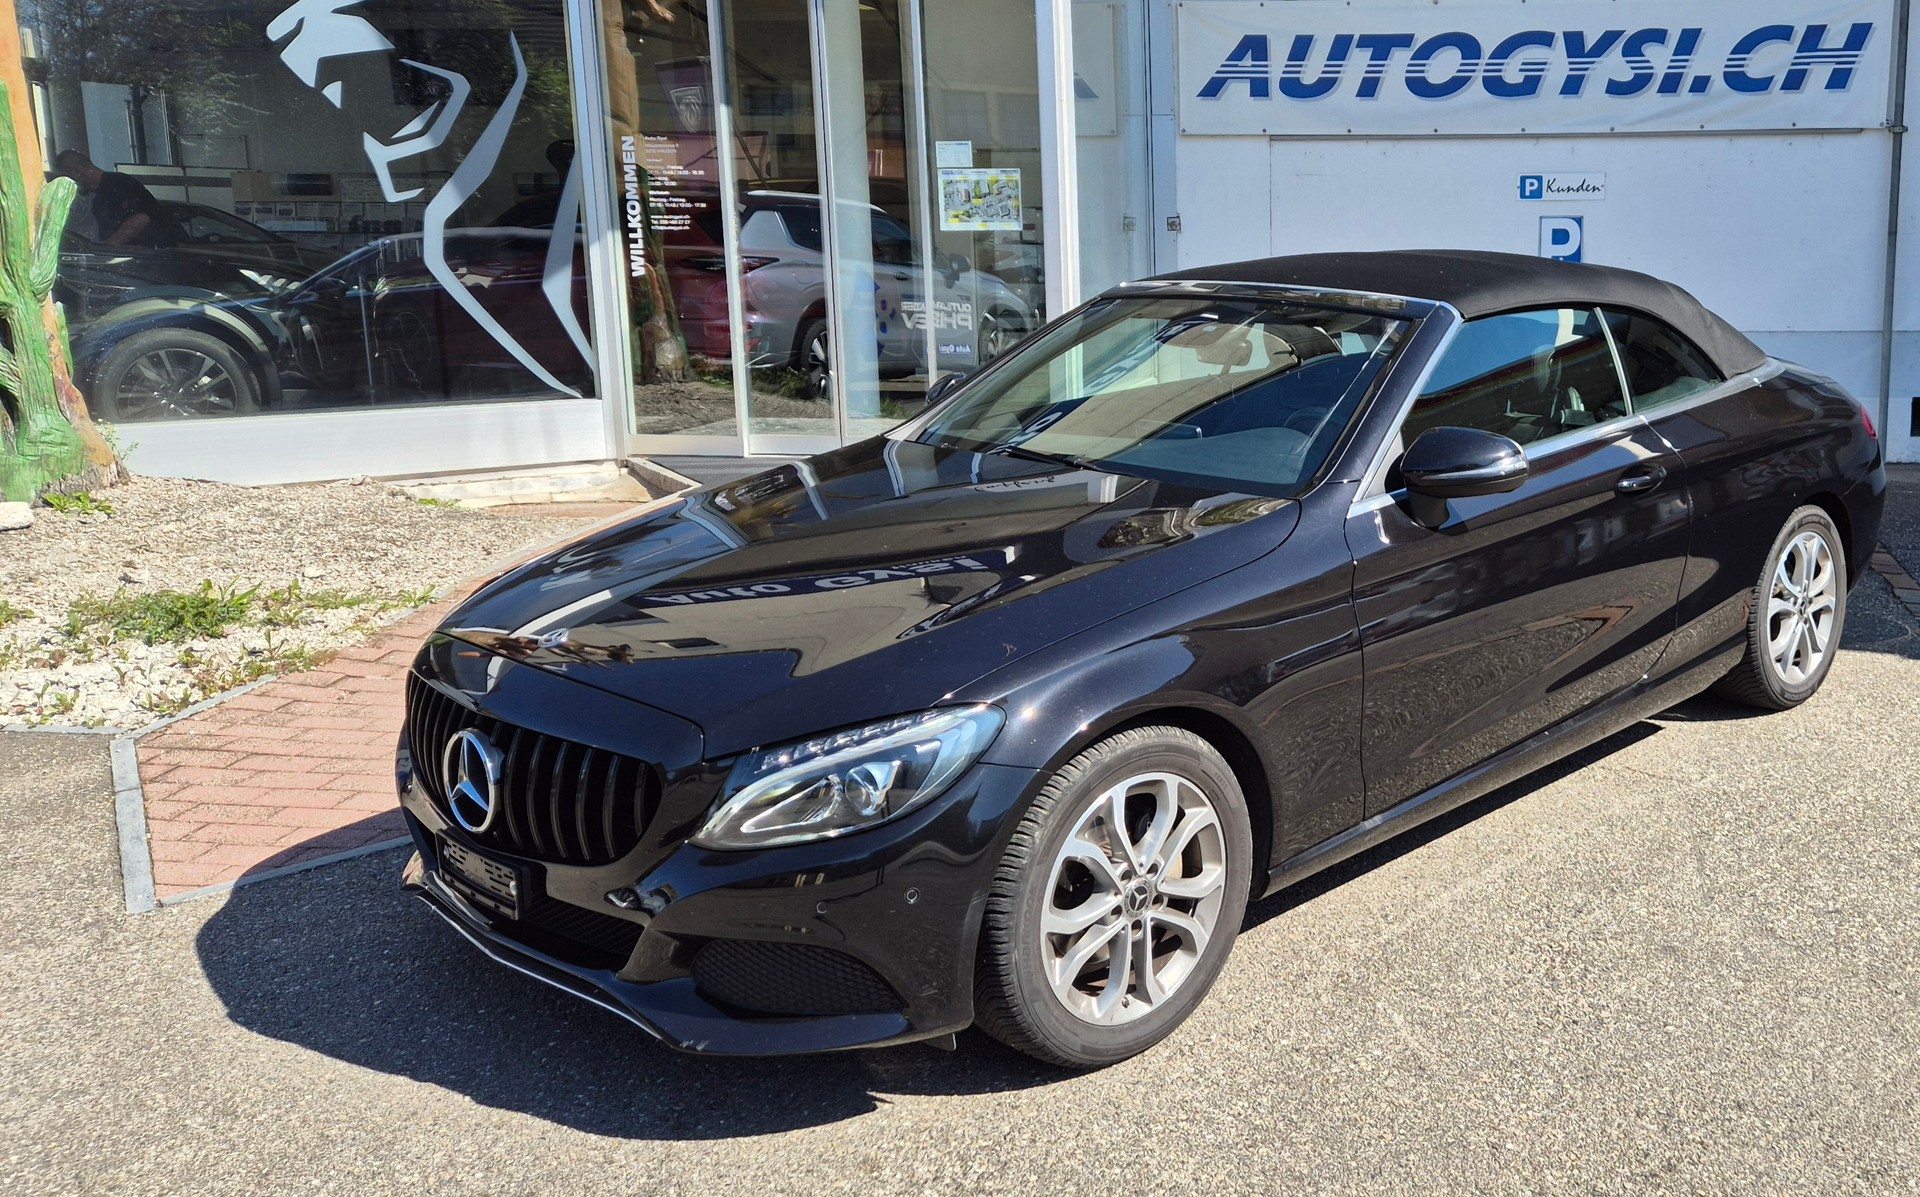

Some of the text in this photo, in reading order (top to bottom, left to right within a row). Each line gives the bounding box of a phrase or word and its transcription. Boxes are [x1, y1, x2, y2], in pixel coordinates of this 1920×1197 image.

[1196, 22, 1874, 100] AUTOGYSI.CH
[621, 135, 646, 278] WILLKOMMEN
[1525, 178, 1601, 196] P Kunden
[1540, 217, 1581, 260] P
